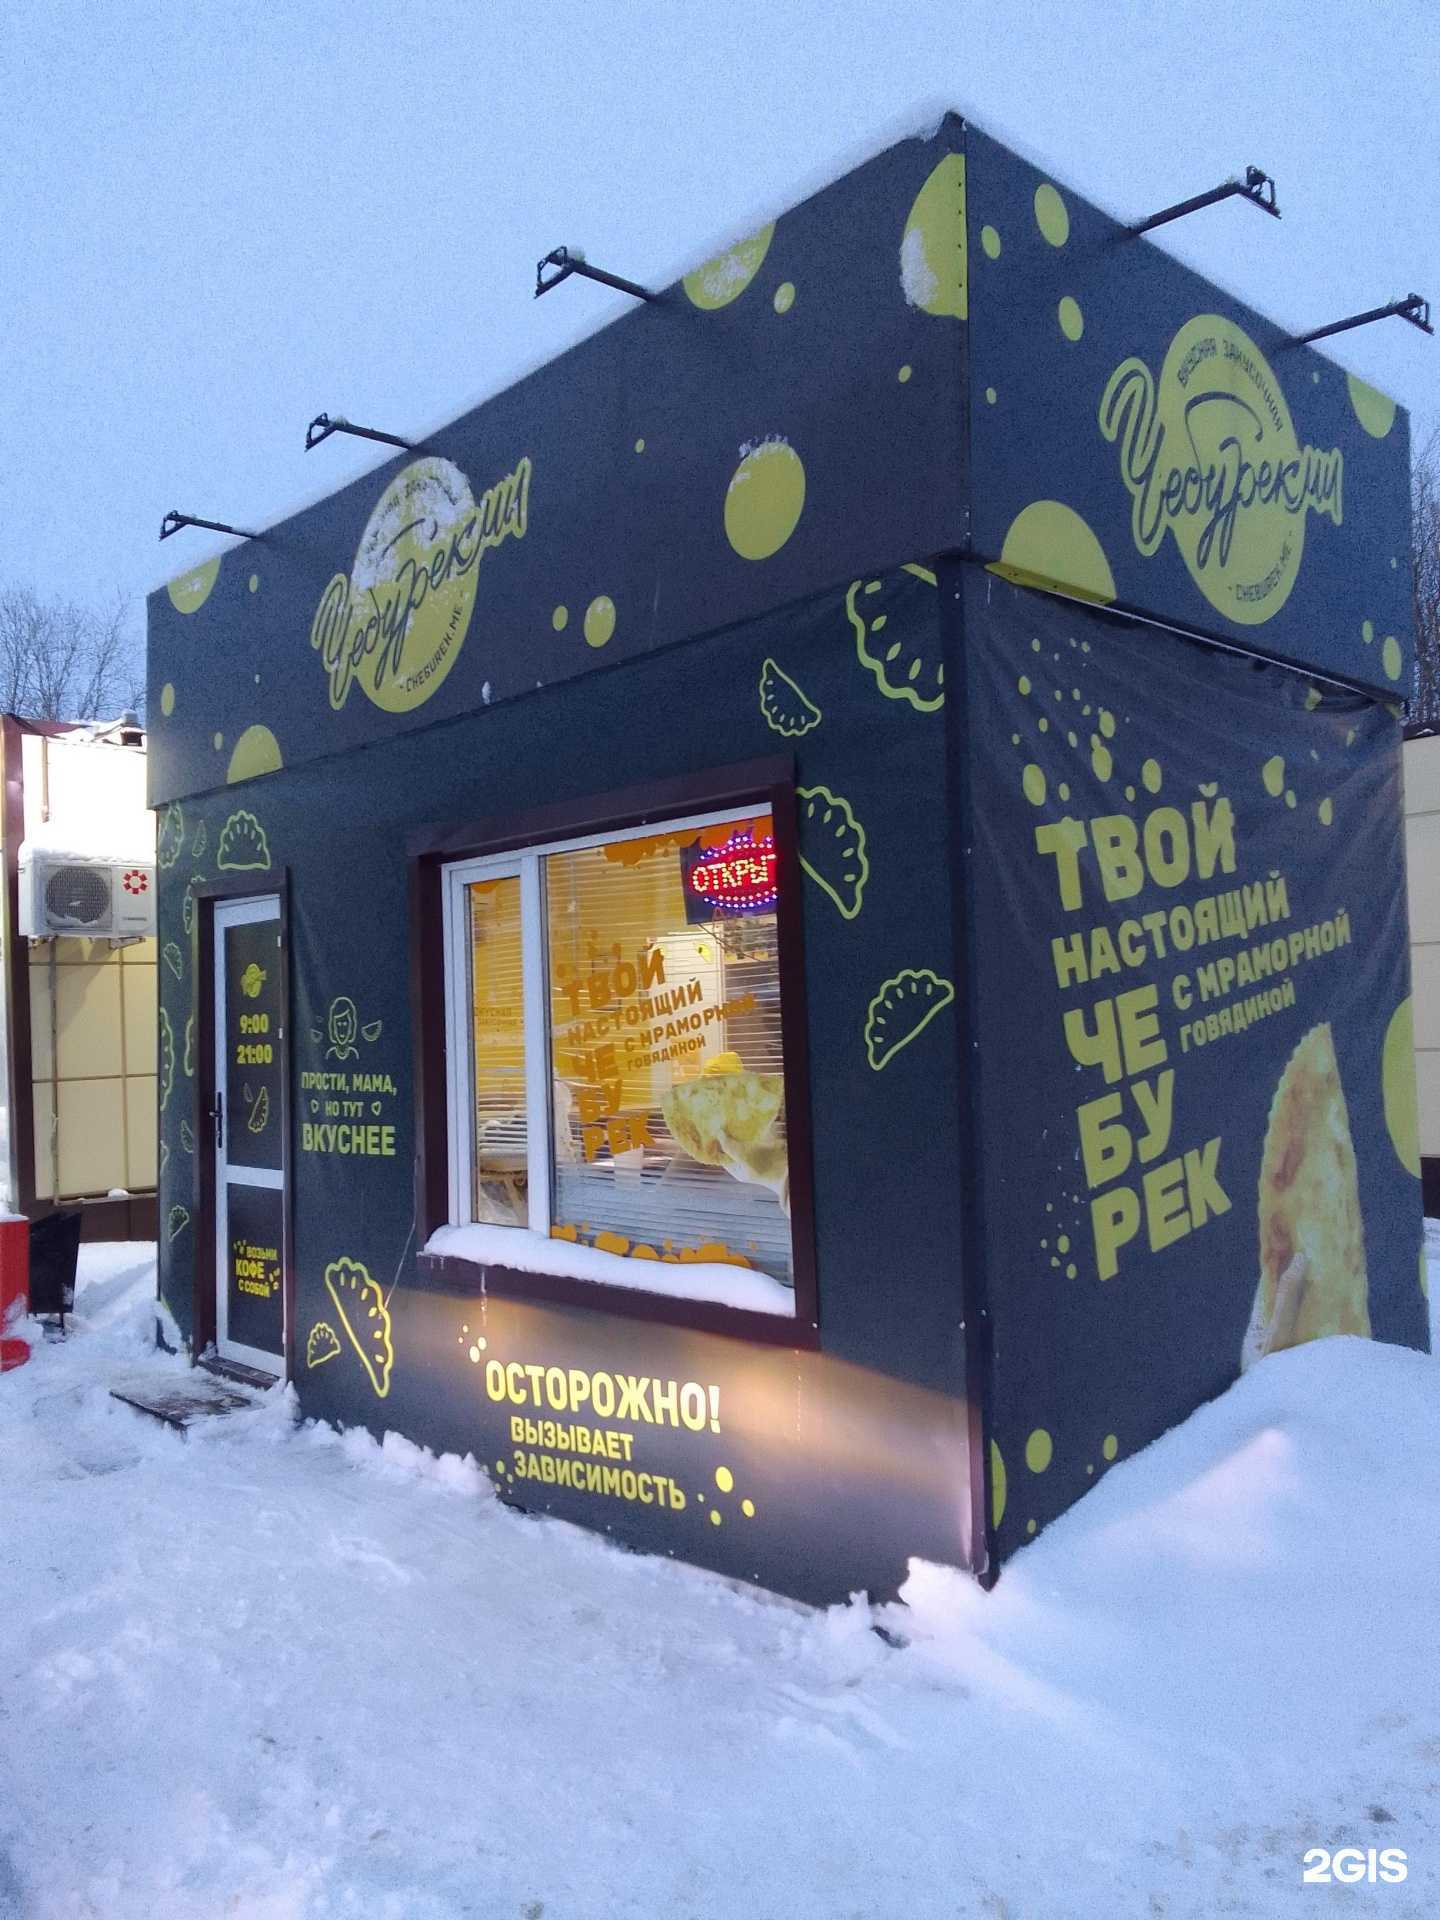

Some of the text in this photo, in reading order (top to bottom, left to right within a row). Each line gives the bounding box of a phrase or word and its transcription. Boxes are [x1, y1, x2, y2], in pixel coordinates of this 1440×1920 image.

[1035, 782, 1238, 912] ТВОЙ
[1051, 870, 1291, 989] НАСТОЯЩИЙ
[565, 943, 666, 1017] ТВОЙ
[1172, 907, 1352, 1010] С МРАМОРНОЙ
[239, 1013, 270, 1034] 9:00
[568, 976, 704, 1045] НАСТОЯЩИЙ
[1063, 983, 1169, 1085] ЧЕ
[1180, 977, 1297, 1053] ГОВЯДИНОЙ
[237, 1044, 273, 1064] 21:00
[571, 1043, 619, 1083] ЧЕ
[624, 1038, 636, 1053] С
[627, 1035, 706, 1073] ГОВЯДИНОЙ
[301, 1071, 398, 1096] ПРОСТИ, МАМА,
[325, 1101, 365, 1118] НО ТУТ
[573, 1078, 623, 1123] БУ
[302, 1122, 397, 1156] ВКУСНЕЕ
[582, 1111, 657, 1163] РЕК
[1076, 1069, 1175, 1188] БУ
[1091, 1137, 1232, 1281] РЕК
[235, 1258, 265, 1280] КОФЕ
[485, 1359, 721, 1434] ОСТОРОЖНО!
[510, 1416, 634, 1462] ВЫЗЫВАЕТ
[513, 1450, 687, 1511] ЗАВИСИМОСТЬ
